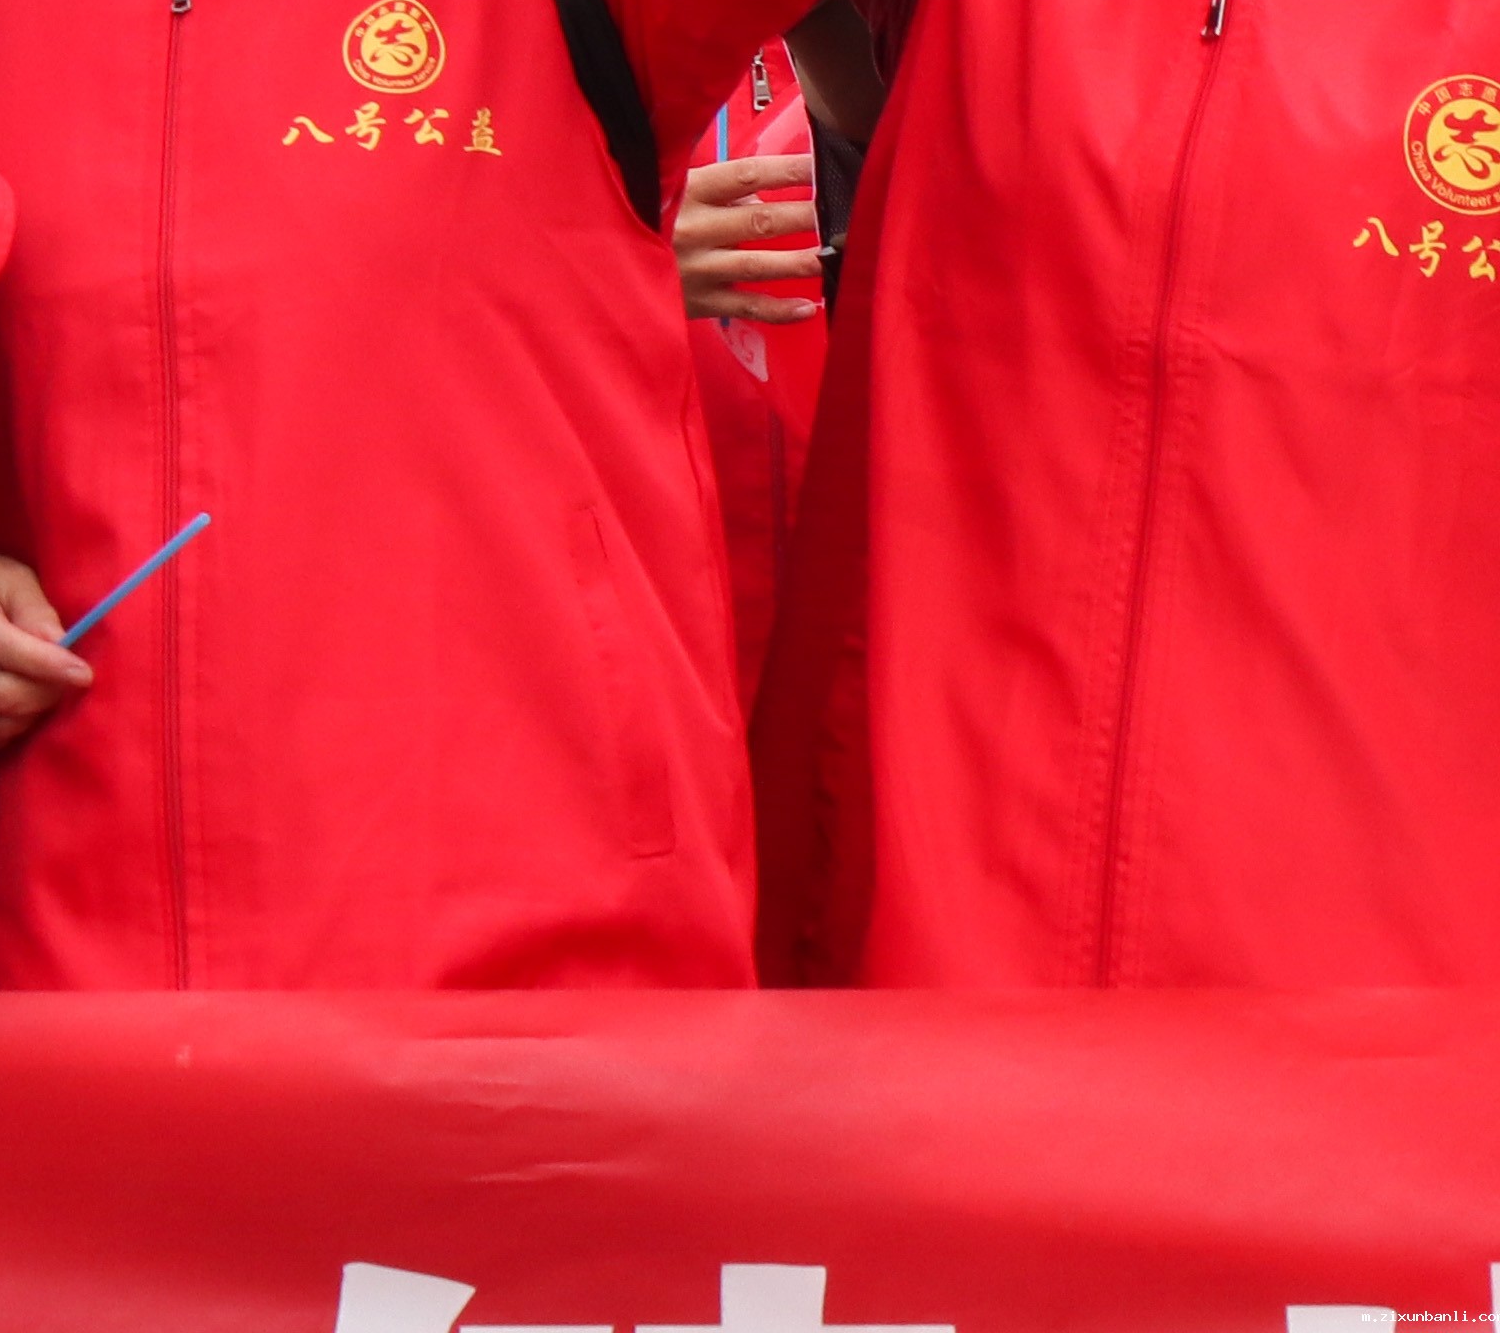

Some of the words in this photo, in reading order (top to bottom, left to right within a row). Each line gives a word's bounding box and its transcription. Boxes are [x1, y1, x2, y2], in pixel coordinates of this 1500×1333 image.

[282, 101, 503, 156] 八号公益
[1411, 141, 1432, 183] China
[1432, 177, 1492, 209] Volunteer
